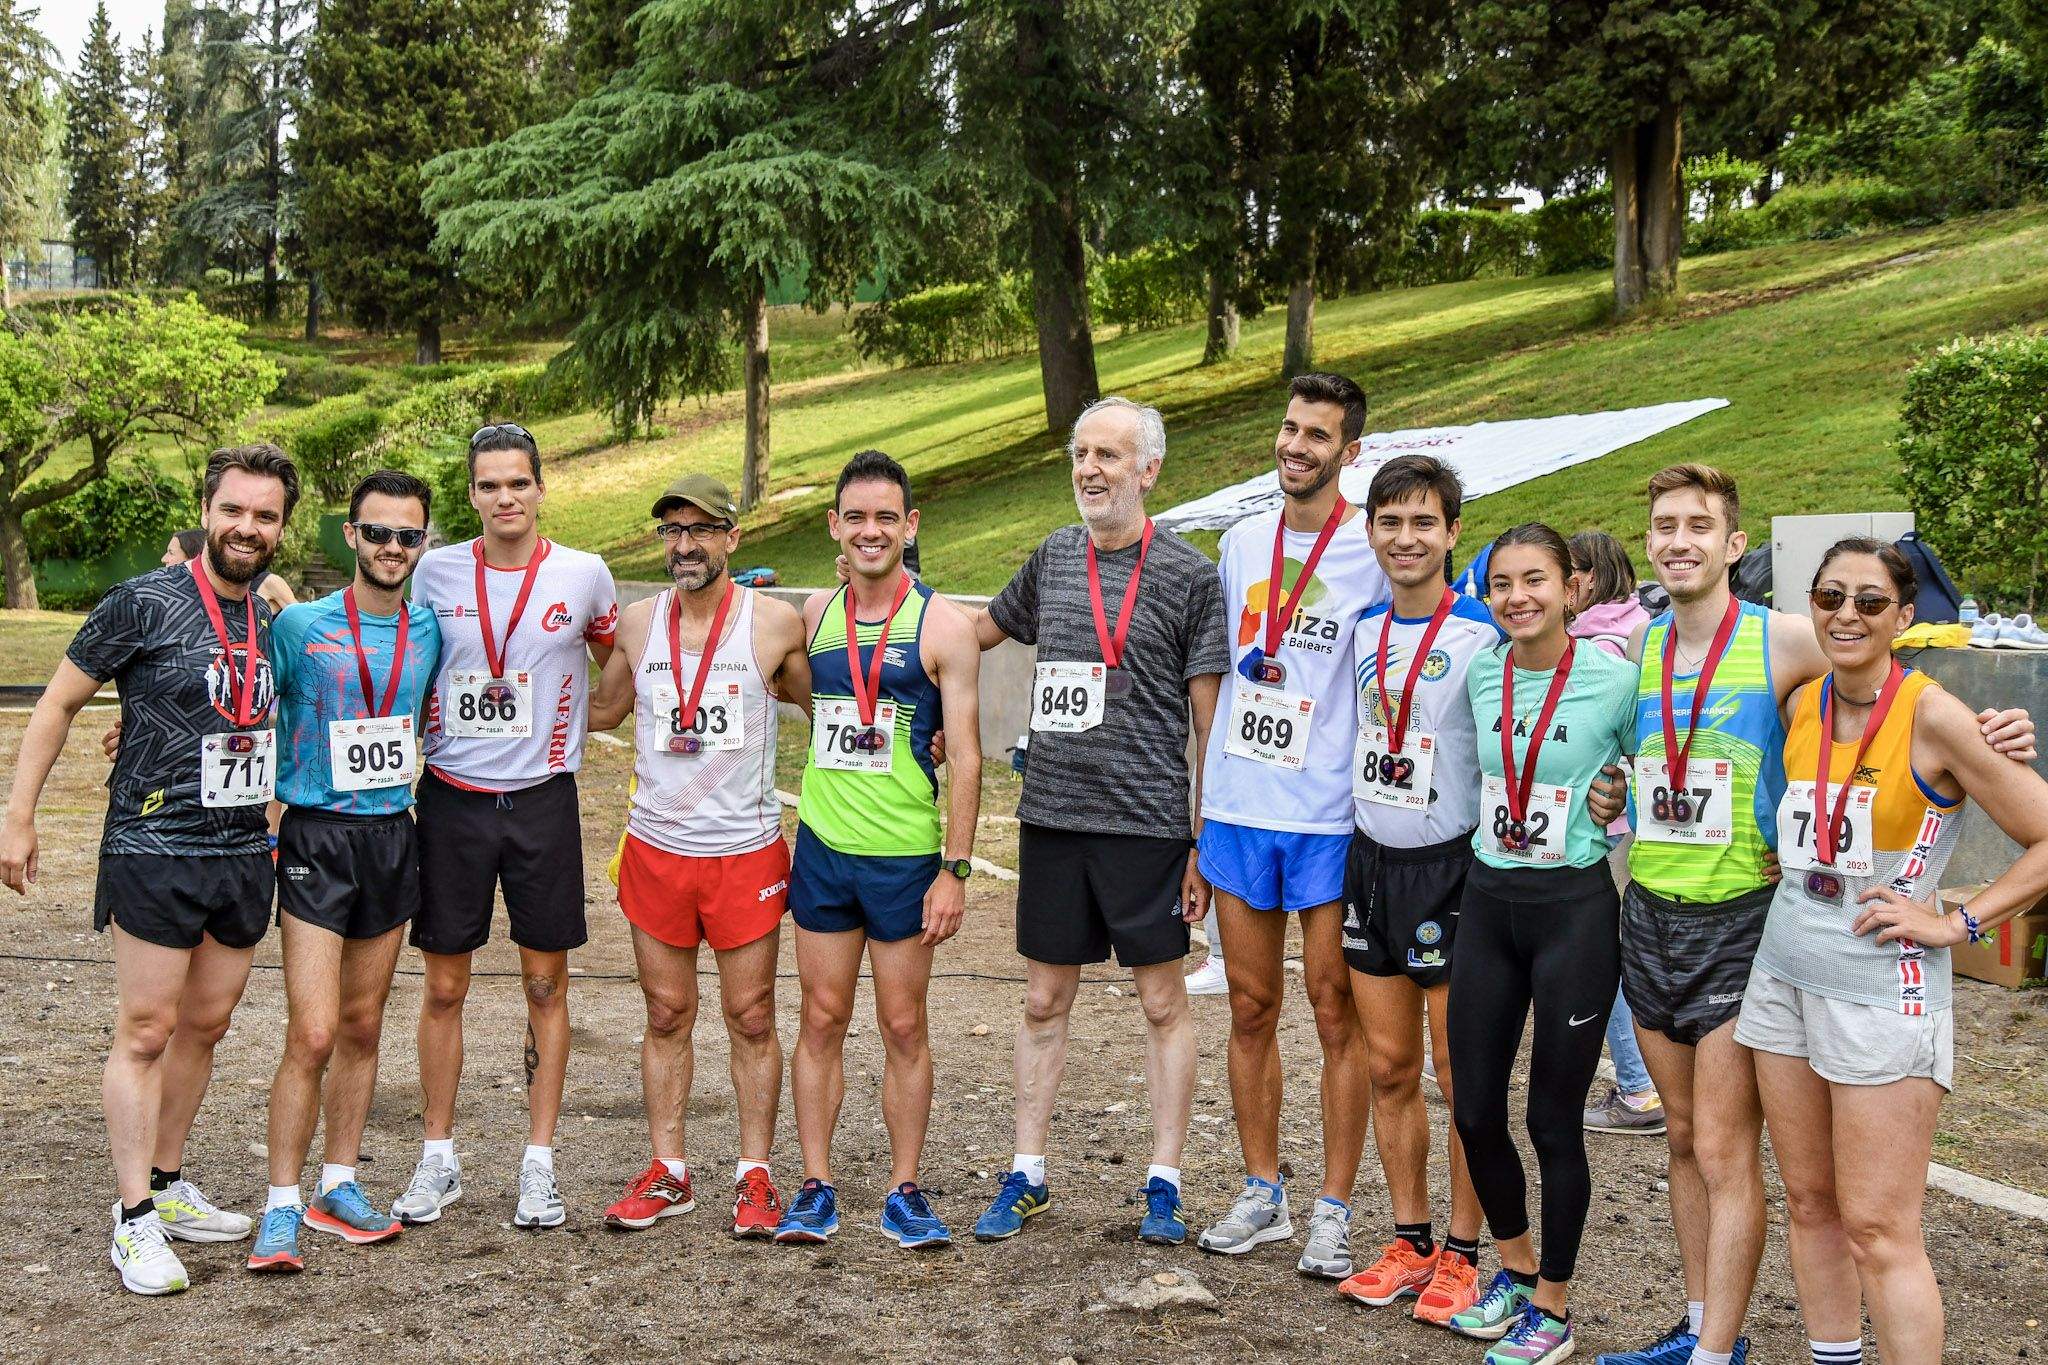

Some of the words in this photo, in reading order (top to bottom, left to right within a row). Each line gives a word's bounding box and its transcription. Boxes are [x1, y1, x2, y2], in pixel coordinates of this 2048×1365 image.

[553, 614, 572, 623] FNA
[1289, 637, 1333, 655] Balears
[459, 692, 516, 721] 866
[1041, 686, 1088, 716] 849
[511, 725, 528, 733] 2023
[671, 705, 728, 735] 803
[1241, 711, 1293, 749] 869
[827, 724, 877, 755] 764
[219, 755, 266, 789] 717
[347, 741, 404, 774] 905
[1282, 755, 1300, 765] 2023
[1364, 751, 1415, 790] 892
[1405, 796, 1424, 805] 2023
[1652, 786, 1713, 823] 867
[1705, 829, 1727, 838] 2023
[1541, 852, 1561, 860] 2023
[1846, 860, 1868, 870] 2023
